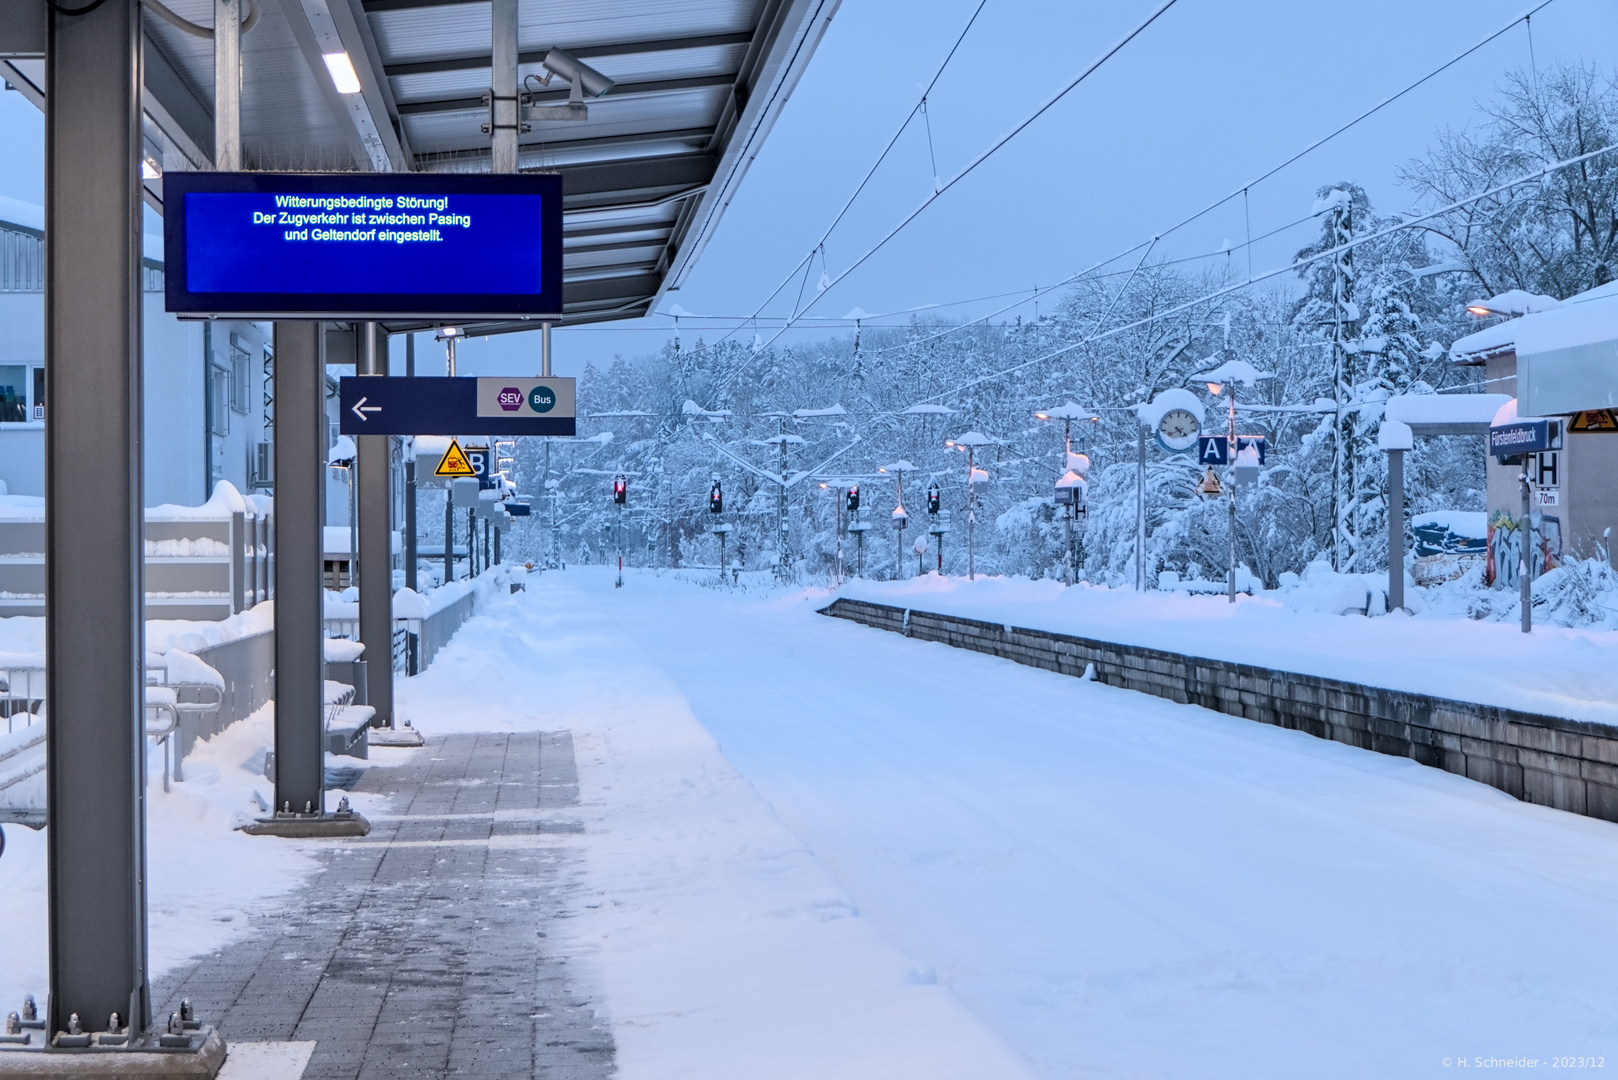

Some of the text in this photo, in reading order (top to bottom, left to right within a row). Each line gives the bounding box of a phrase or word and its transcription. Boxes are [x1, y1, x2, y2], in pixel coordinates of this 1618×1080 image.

[275, 195, 448, 211] Witterungsbedingte Störung!
[253, 211, 471, 228] Der Zugverkehr ist zwischen Pasing
[284, 228, 444, 244] und Geltendorf eingestellt.
[500, 393, 552, 404] SEV Bus
[1491, 426, 1537, 446] Fürstenfeldbruck
[1203, 438, 1220, 459] A
[469, 453, 485, 475] B
[1538, 452, 1557, 485] H
[1539, 492, 1555, 505] 70m
